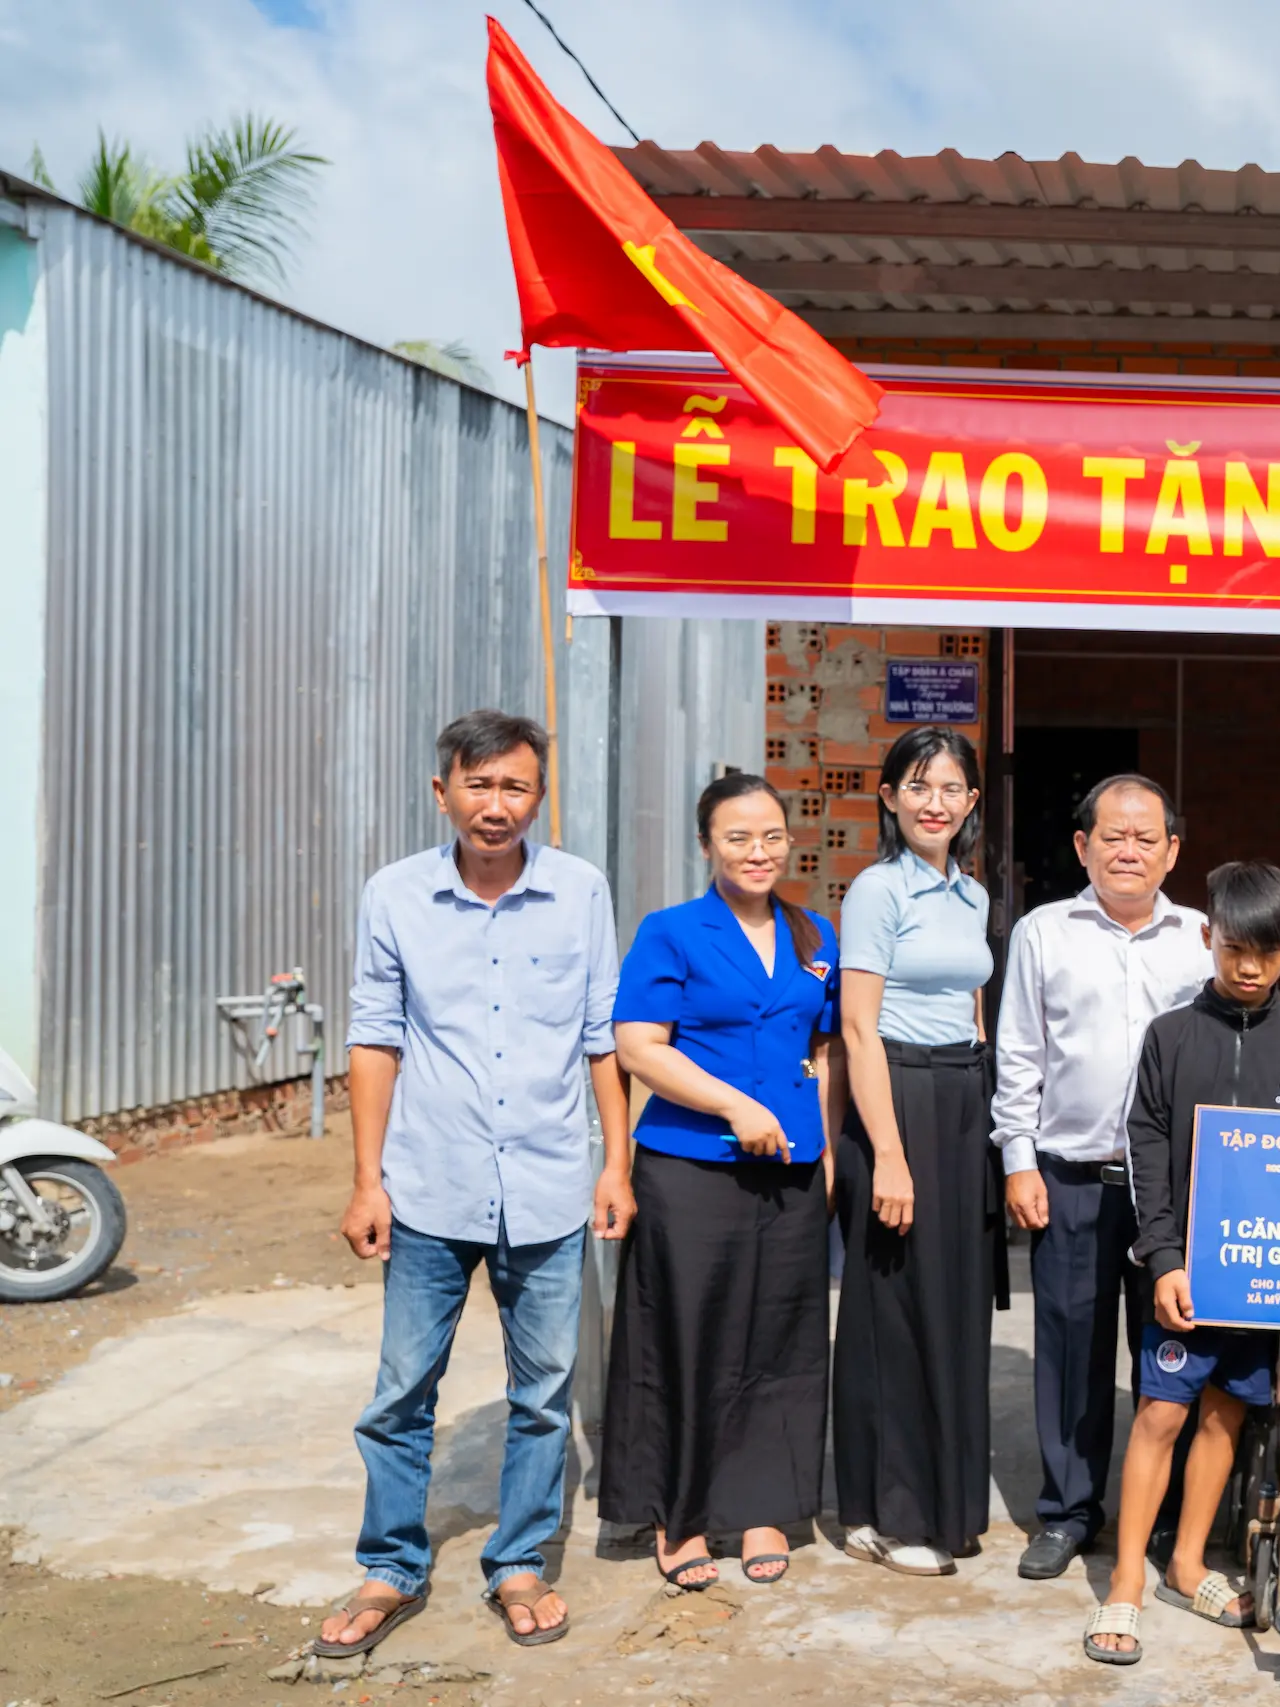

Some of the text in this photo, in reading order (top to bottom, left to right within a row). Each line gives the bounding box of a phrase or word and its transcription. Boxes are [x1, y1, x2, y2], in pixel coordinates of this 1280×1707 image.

[609, 395, 730, 541] LỄ
[774, 447, 1049, 552] TRAO
[1219, 1128, 1257, 1151] TẬP
[1220, 1219, 1230, 1237] 1
[1220, 1243, 1263, 1268] (TRỊ
[1250, 1278, 1274, 1290] CHO
[1247, 1292, 1262, 1304] XÃ
